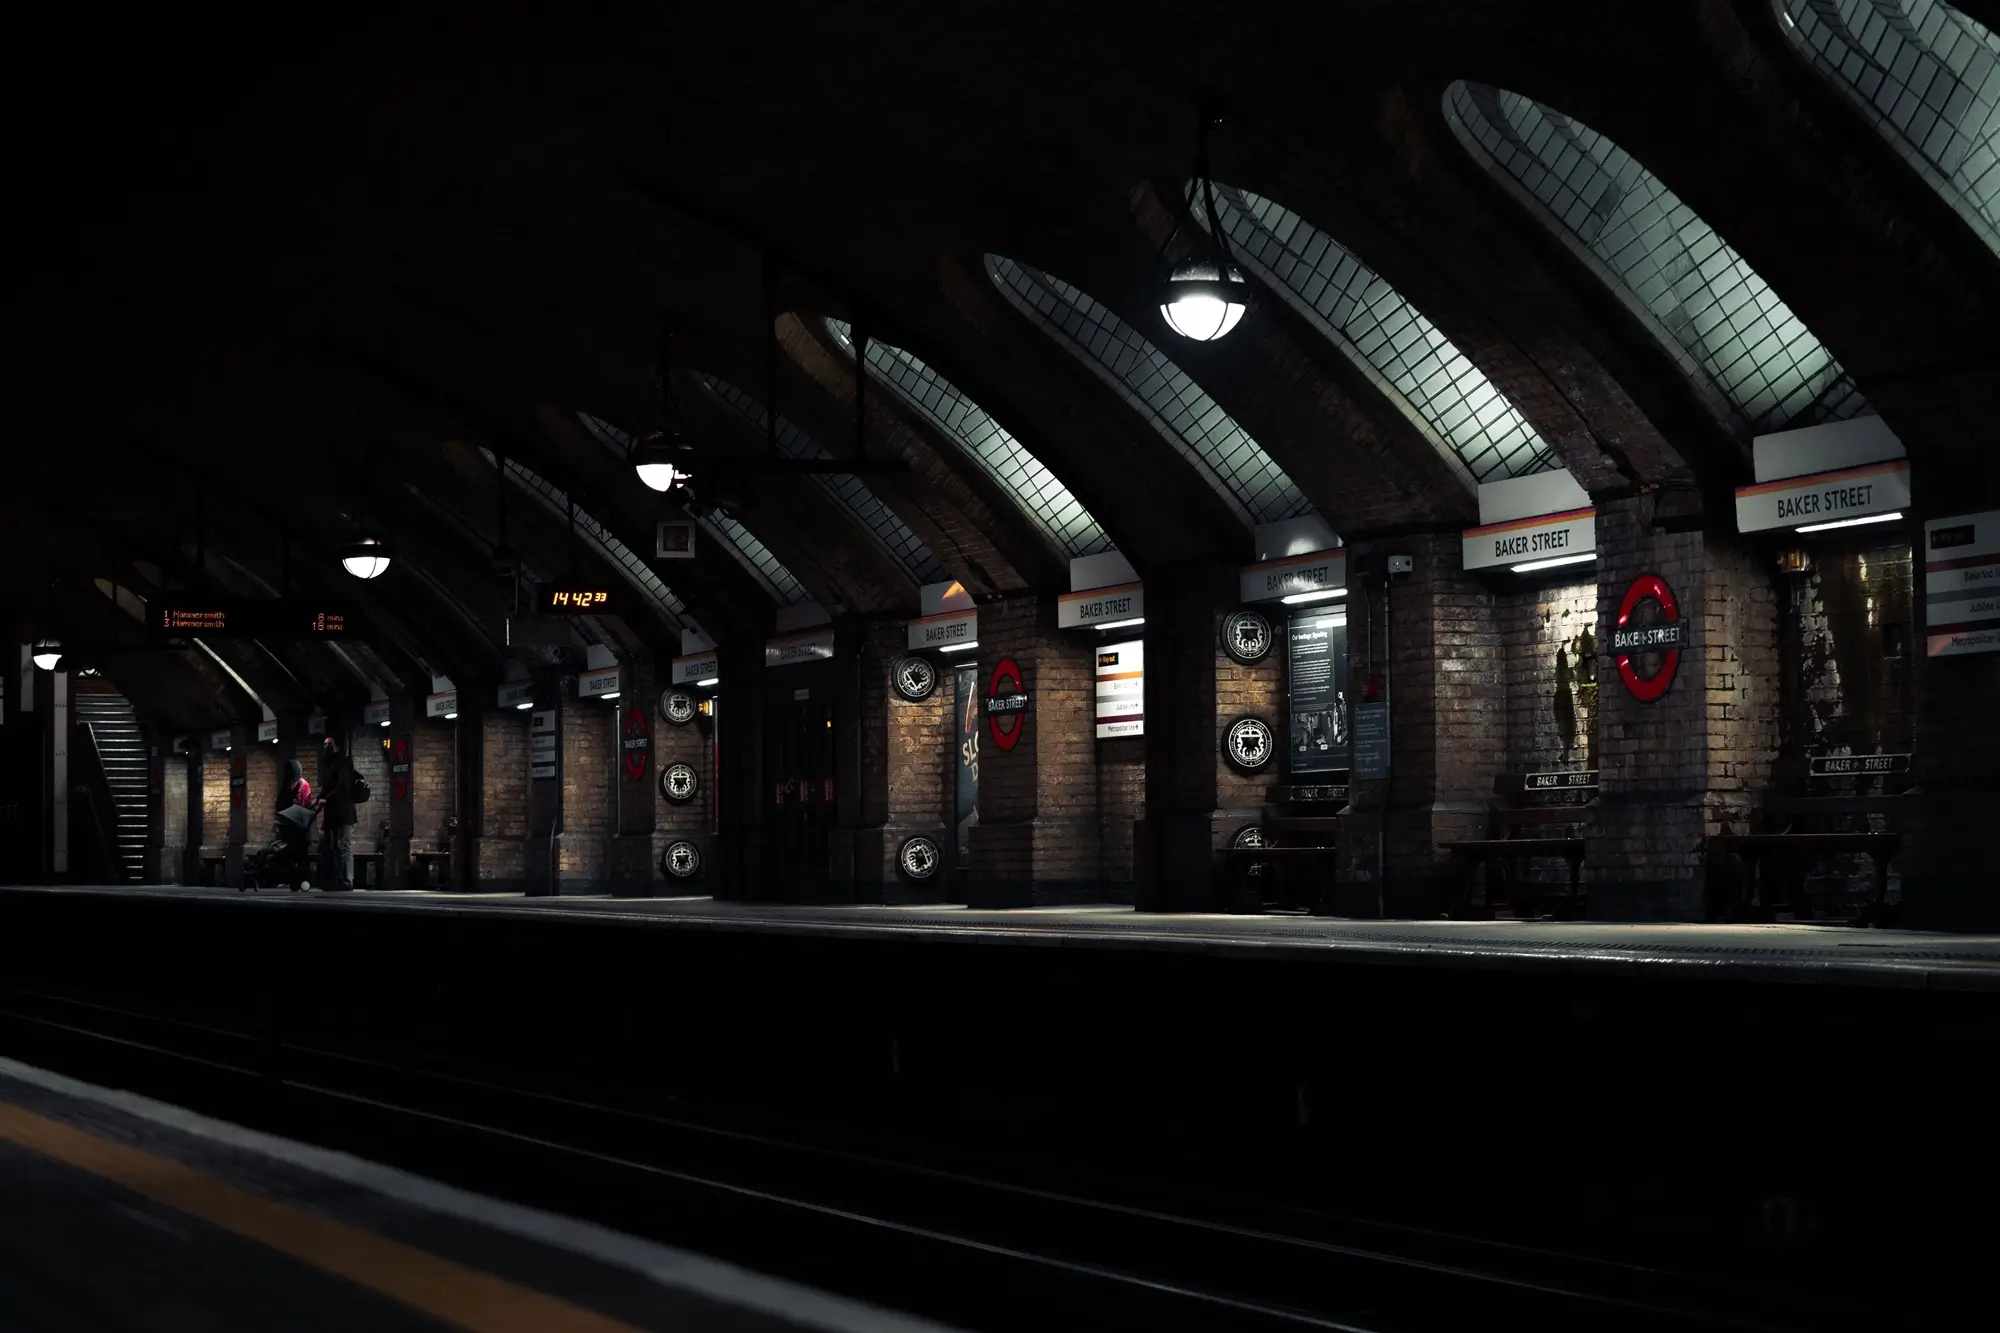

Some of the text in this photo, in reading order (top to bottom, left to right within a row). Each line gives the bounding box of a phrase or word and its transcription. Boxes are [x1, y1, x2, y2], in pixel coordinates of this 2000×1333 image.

[1777, 485, 1873, 519] BAKER STREET
[1495, 529, 1570, 558] BAKER STREET
[1267, 566, 1329, 591] BAKER STREET
[552, 592, 607, 607] 14 42 33
[172, 610, 226, 620] Hammersmith
[327, 614, 344, 622] mins
[1080, 597, 1132, 619] BAKER STREET
[172, 619, 225, 629] Hammersmith
[327, 622, 344, 631] mins
[925, 623, 967, 642] BAKER STREET
[1614, 627, 1680, 648] BAKER STREET
[685, 661, 716, 677] BAKER STREET
[988, 697, 1025, 712] BAKER STREET
[1824, 757, 1894, 771] BAKER STREET
[1536, 774, 1591, 787] BAKER STREET
